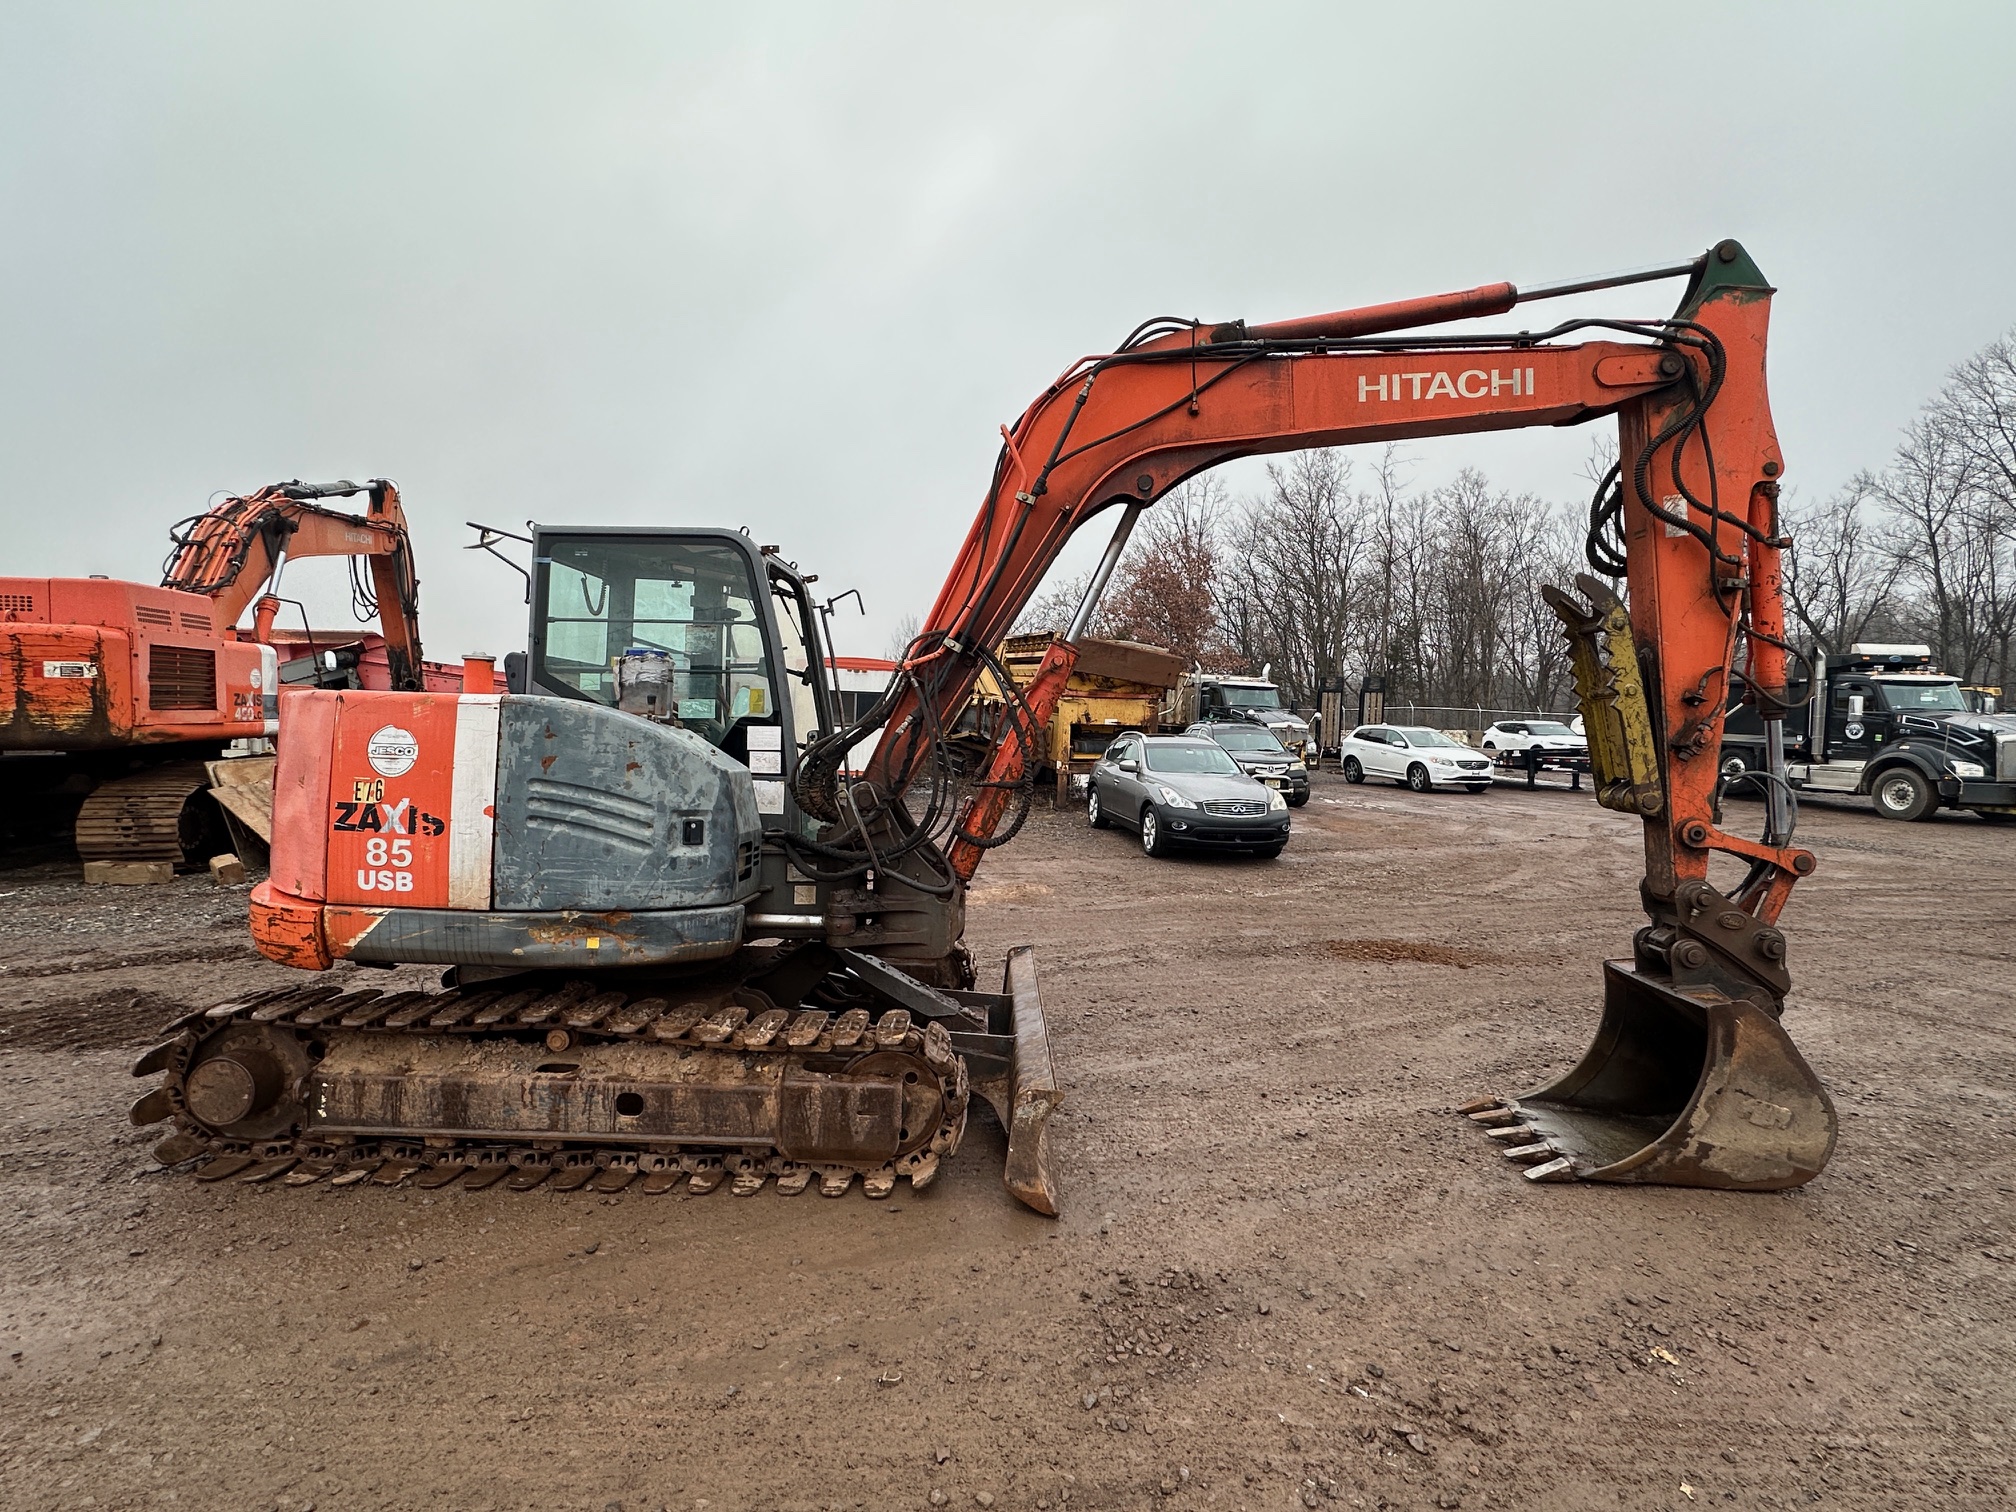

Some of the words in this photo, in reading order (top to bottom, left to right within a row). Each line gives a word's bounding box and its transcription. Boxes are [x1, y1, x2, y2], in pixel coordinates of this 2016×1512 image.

[1358, 367, 1535, 402] HITACHI
[234, 691, 262, 706] ZAXIS
[371, 745, 415, 756] JESCO
[333, 797, 445, 837] ZAXIS
[365, 837, 413, 867] 85
[357, 870, 414, 892] USB
